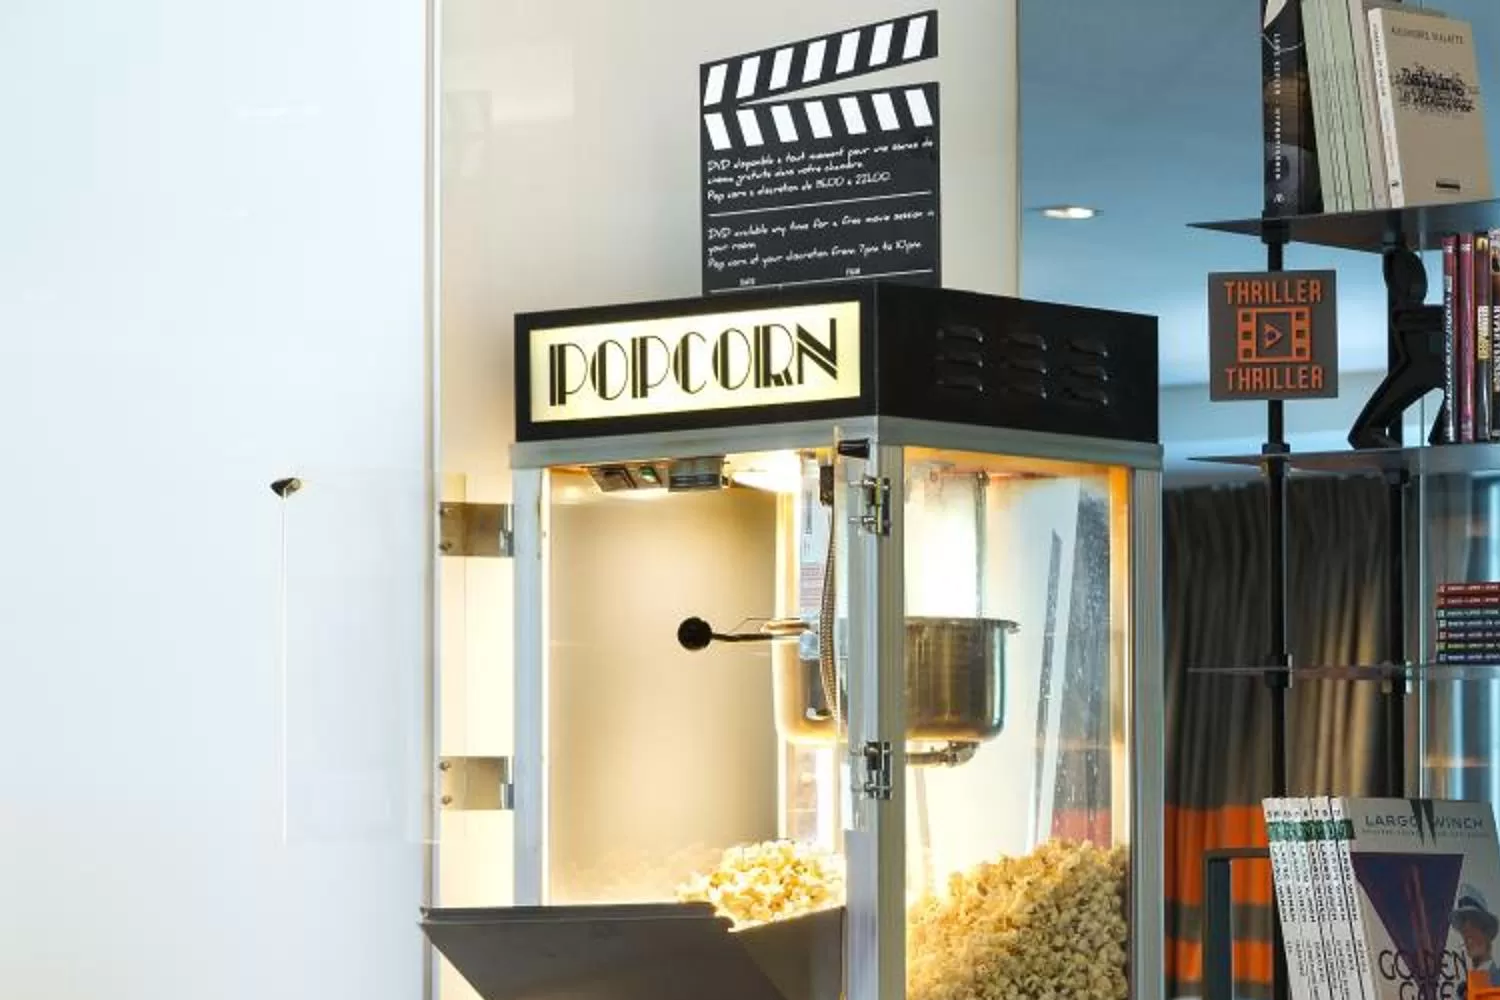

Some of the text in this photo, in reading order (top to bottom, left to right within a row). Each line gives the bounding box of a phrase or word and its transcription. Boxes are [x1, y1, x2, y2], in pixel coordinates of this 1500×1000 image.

[707, 160, 731, 172] DVD
[847, 147, 871, 166] pour
[922, 136, 933, 147] de
[707, 227, 731, 240] DVD
[734, 223, 768, 237] available
[789, 219, 809, 230] time
[813, 217, 829, 229] for
[865, 214, 891, 223] movie
[893, 209, 923, 221] session
[707, 257, 725, 271] Pop
[762, 254, 783, 268] your
[708, 243, 729, 256] your
[1224, 279, 1322, 305] THRILLER
[549, 317, 839, 406] POPCORN
[1225, 366, 1325, 392] THRILLER
[1365, 814, 1483, 830] LARGO WINCH
